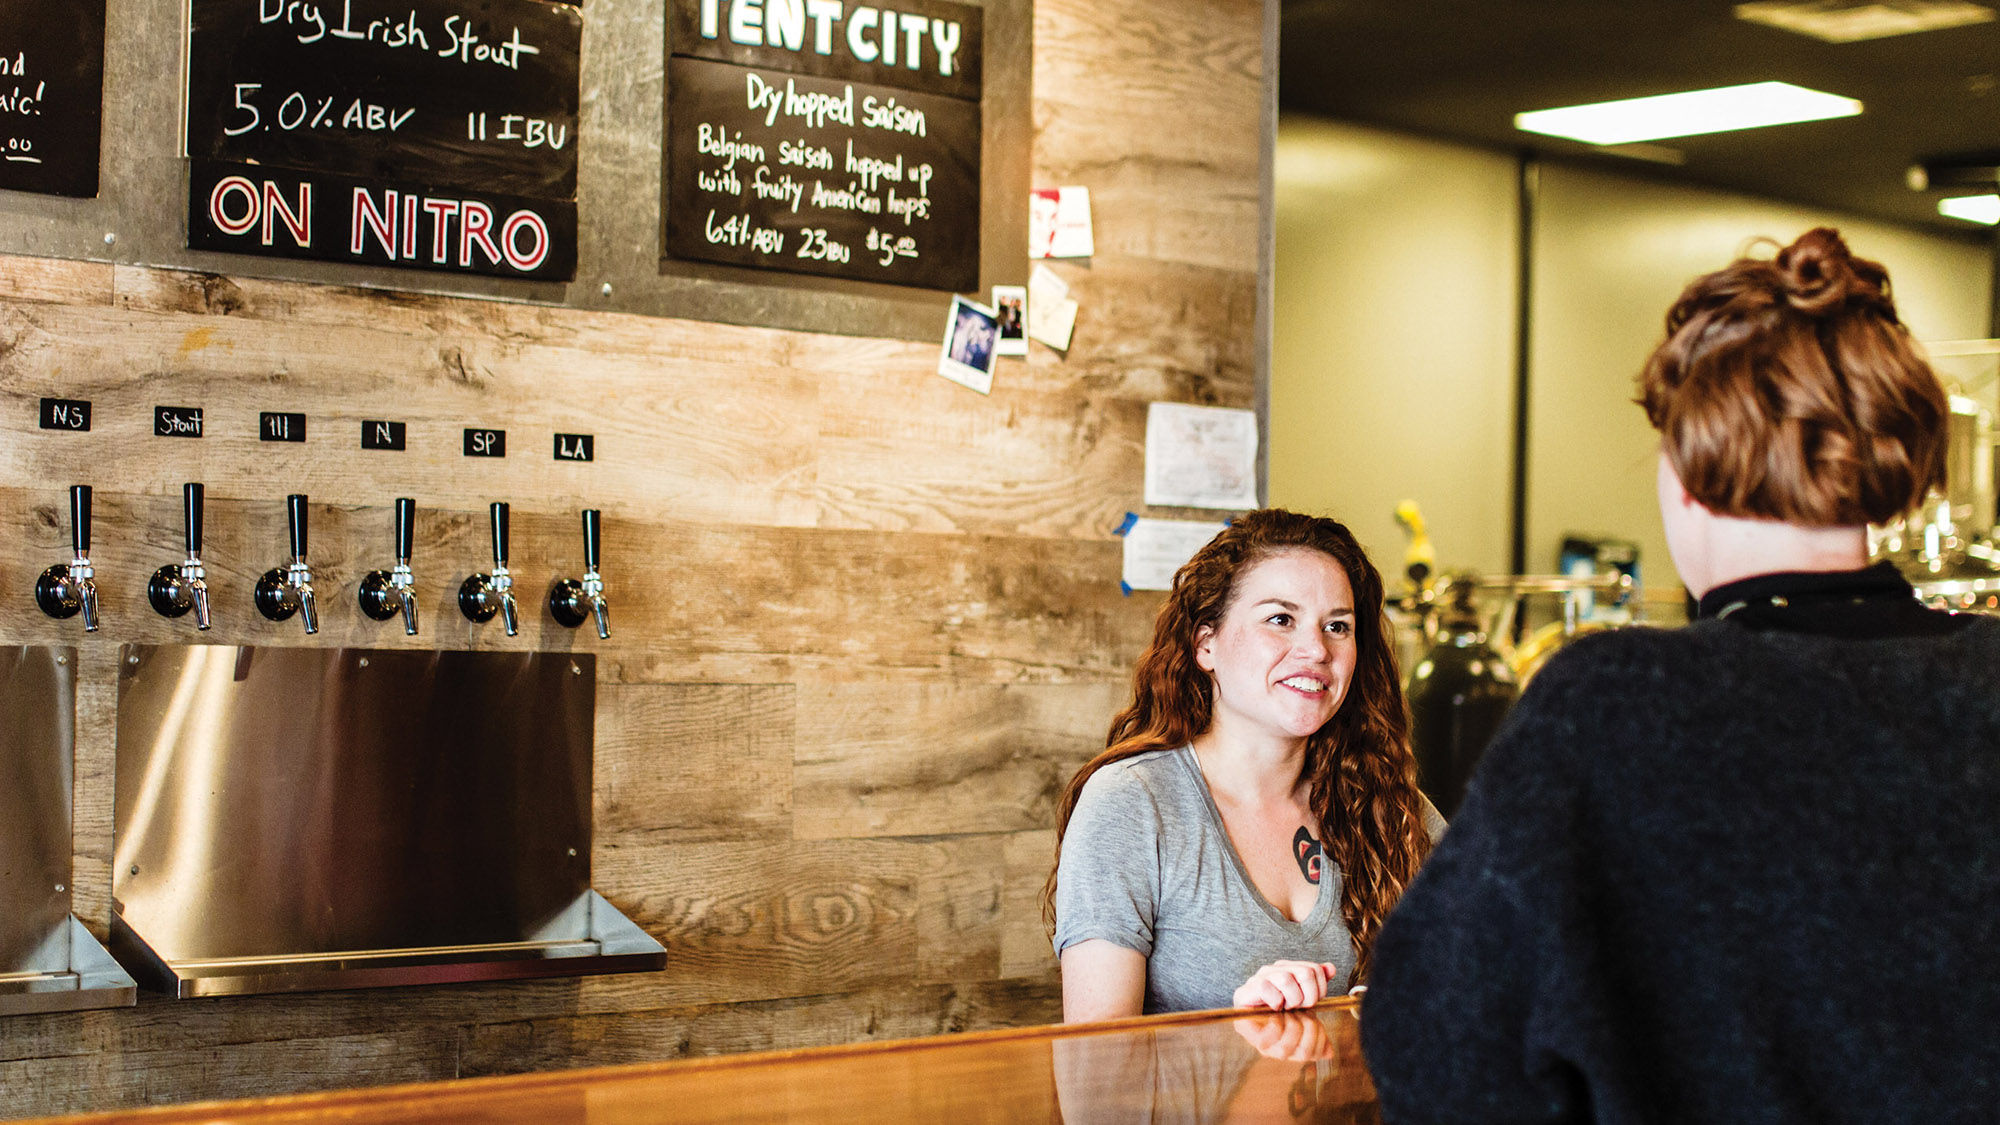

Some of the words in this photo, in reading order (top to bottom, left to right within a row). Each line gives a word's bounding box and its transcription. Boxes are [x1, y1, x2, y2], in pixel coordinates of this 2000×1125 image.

[259, 0, 326, 44] Dry
[330, 0, 429, 50] Irish
[438, 15, 540, 70] Stout
[224, 83, 333, 136] 5.0%
[342, 98, 416, 131] ABV
[496, 115, 566, 149] IBU
[698, 123, 765, 171] Belgian
[845, 138, 902, 192] hopped
[908, 163, 933, 197] up
[698, 169, 741, 196] with
[751, 165, 803, 213] fruity
[811, 179, 881, 214] American
[209, 175, 312, 248] ON
[350, 186, 550, 272] NITRO
[53, 404, 83, 428] NS
[160, 411, 202, 435] Stout
[376, 422, 392, 444] N
[473, 432, 496, 455] SP
[561, 436, 586, 460] LA
